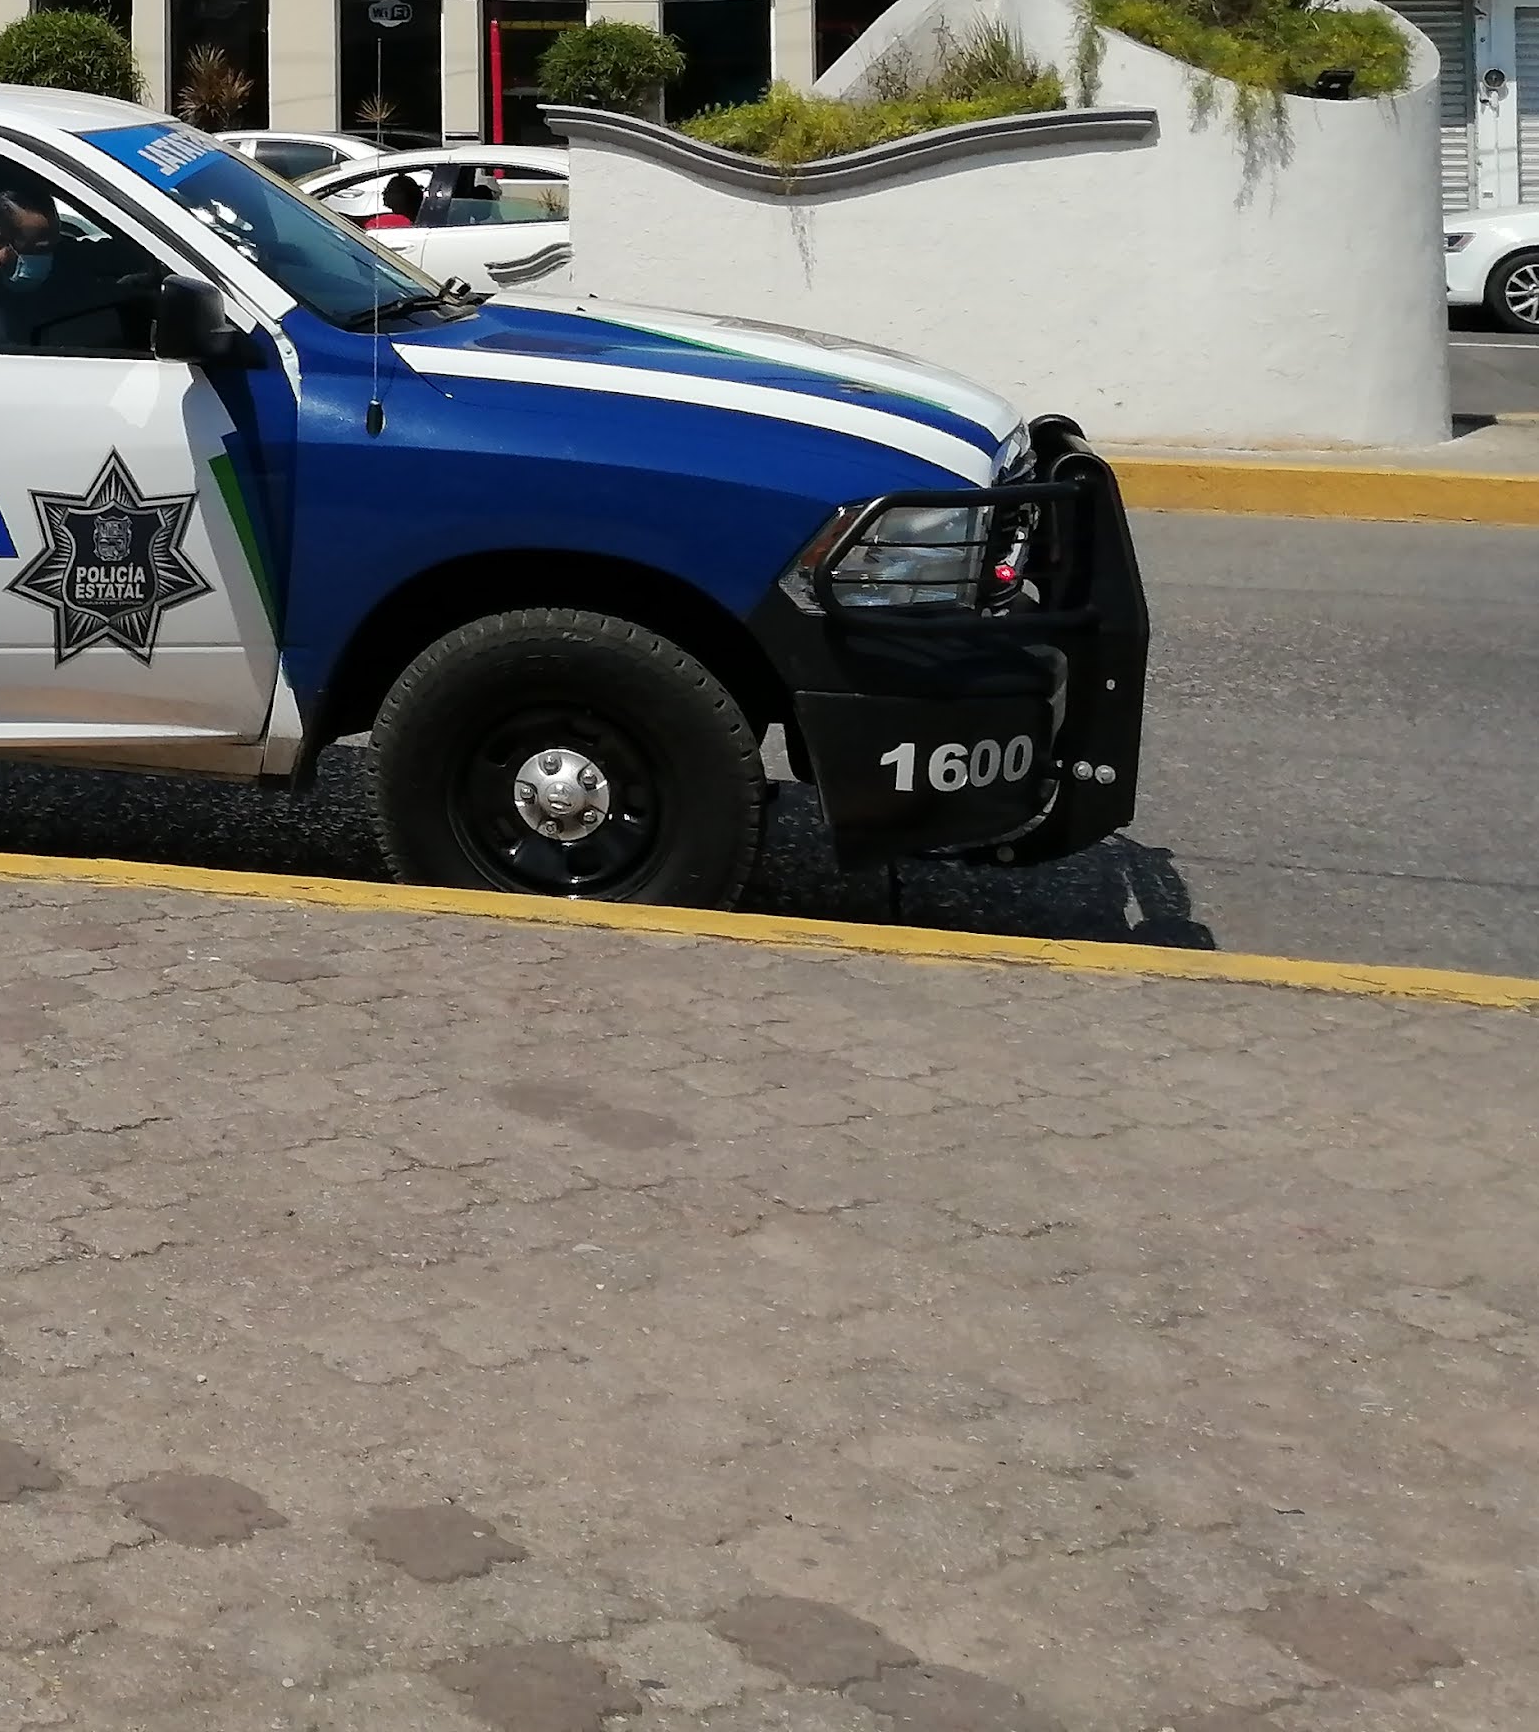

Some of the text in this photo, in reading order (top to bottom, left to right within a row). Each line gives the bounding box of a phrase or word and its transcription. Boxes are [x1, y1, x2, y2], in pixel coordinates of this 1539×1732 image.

[76, 563, 146, 583] POLICÍA
[75, 583, 144, 599] ESTATAL
[880, 735, 1033, 792] 1600
